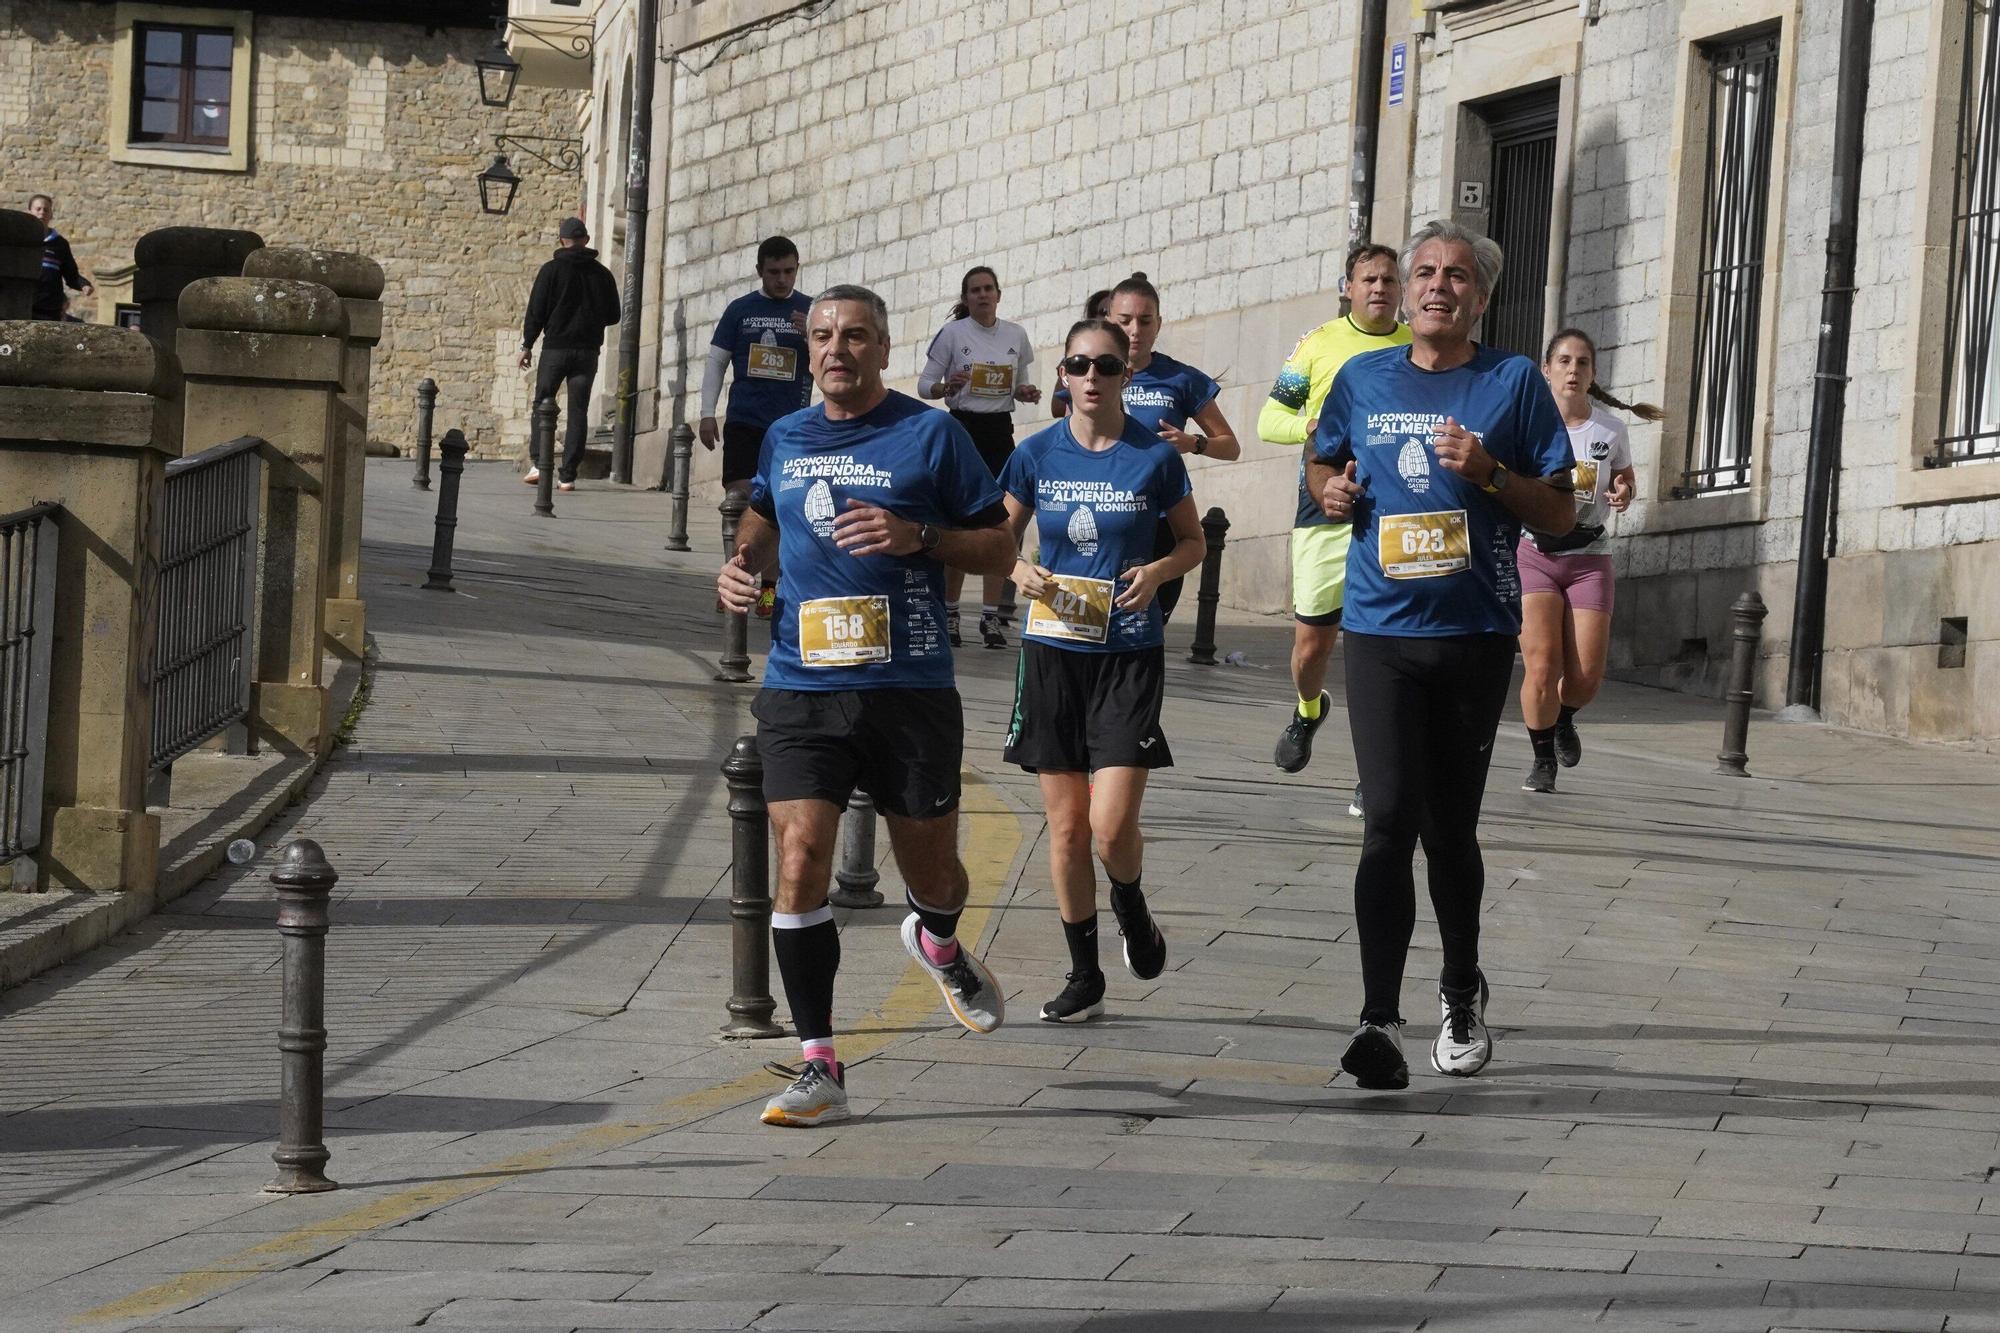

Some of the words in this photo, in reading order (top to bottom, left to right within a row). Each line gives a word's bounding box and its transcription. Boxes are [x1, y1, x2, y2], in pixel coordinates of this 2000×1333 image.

[761, 353, 784, 368] 263
[985, 372, 1005, 386] 122
[1122, 391, 1162, 402] ENDRA
[1368, 415, 1378, 423] LA
[1379, 413, 1445, 424] CONQUISTA
[784, 459, 793, 469] LA
[793, 455, 854, 466] CONQUISTA
[792, 464, 875, 479] ALMENDRA
[875, 470, 892, 478] REN
[832, 476, 892, 489] KONKISTA
[1038, 479, 1050, 488] LA
[1051, 480, 1113, 491] CONQUISTA
[1052, 490, 1135, 502] ALMENDRA
[1095, 502, 1148, 512] KONKISTA
[1402, 528, 1445, 555] 623
[1051, 591, 1088, 617] 421
[822, 614, 864, 641] 158
[831, 641, 858, 649] EDUARDO
